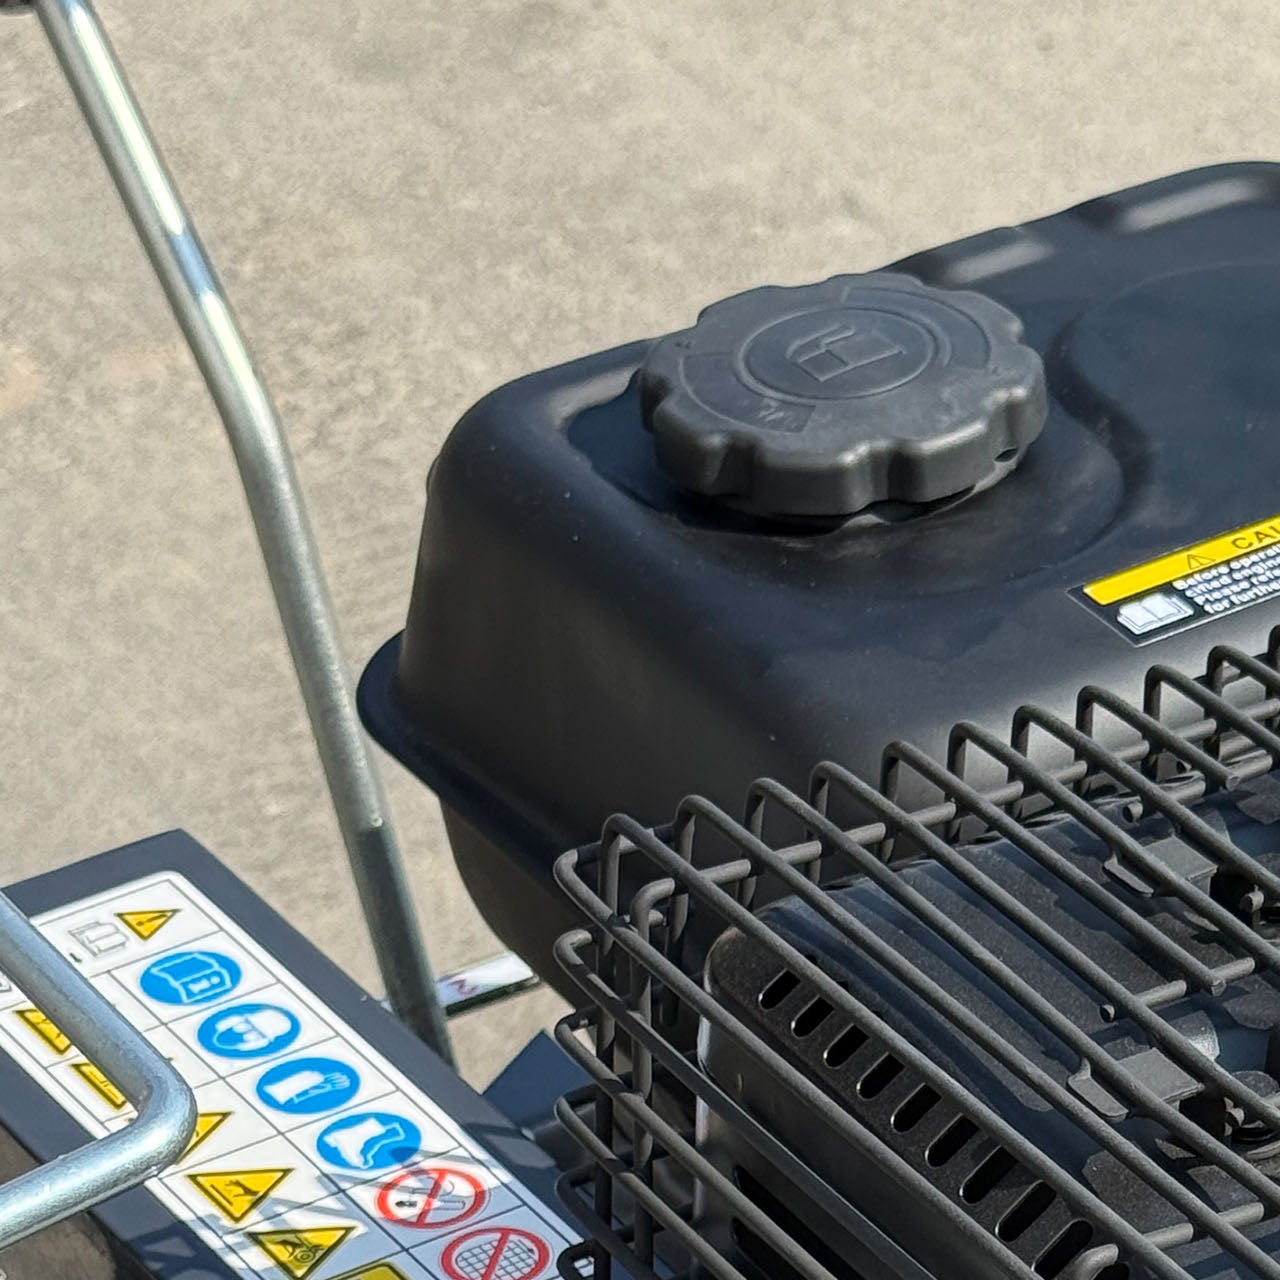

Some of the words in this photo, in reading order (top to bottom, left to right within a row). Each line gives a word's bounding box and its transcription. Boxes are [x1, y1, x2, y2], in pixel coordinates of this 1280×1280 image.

[1172, 564, 1230, 591] Before
[1193, 580, 1251, 606] Please
[1203, 598, 1231, 614] for
